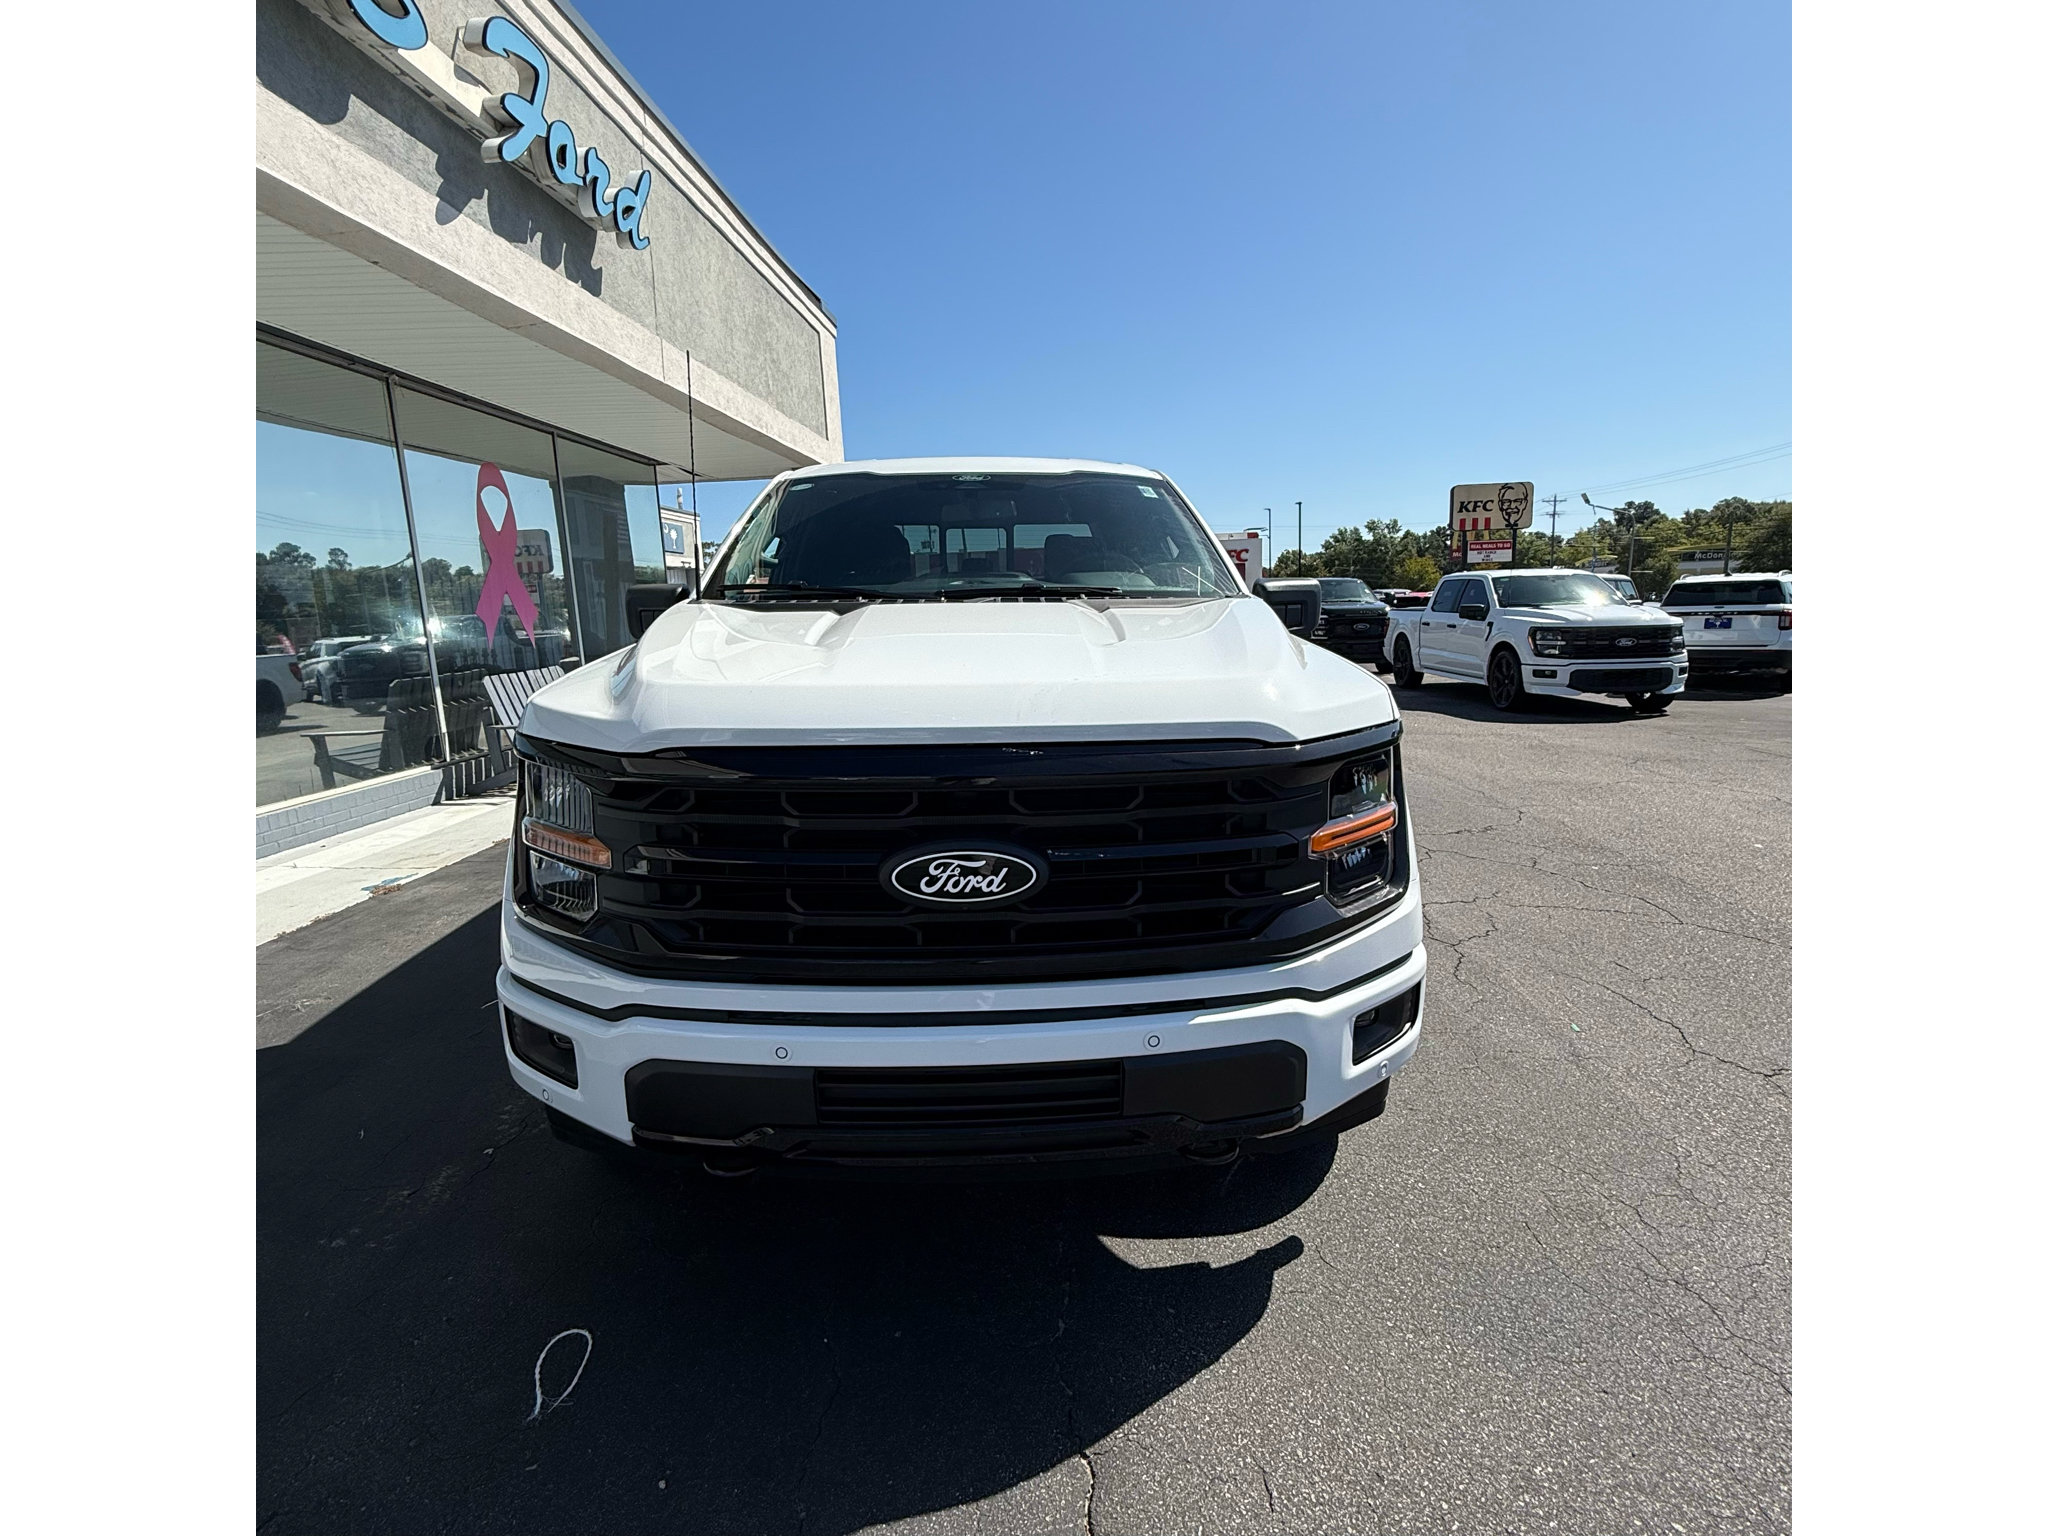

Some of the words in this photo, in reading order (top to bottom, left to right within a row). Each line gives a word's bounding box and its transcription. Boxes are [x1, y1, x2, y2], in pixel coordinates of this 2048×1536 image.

[483, 16, 651, 250] Ford
[1457, 499, 1494, 513] KFC
[1227, 549, 1249, 562] FC
[920, 859, 1008, 893] Ford
